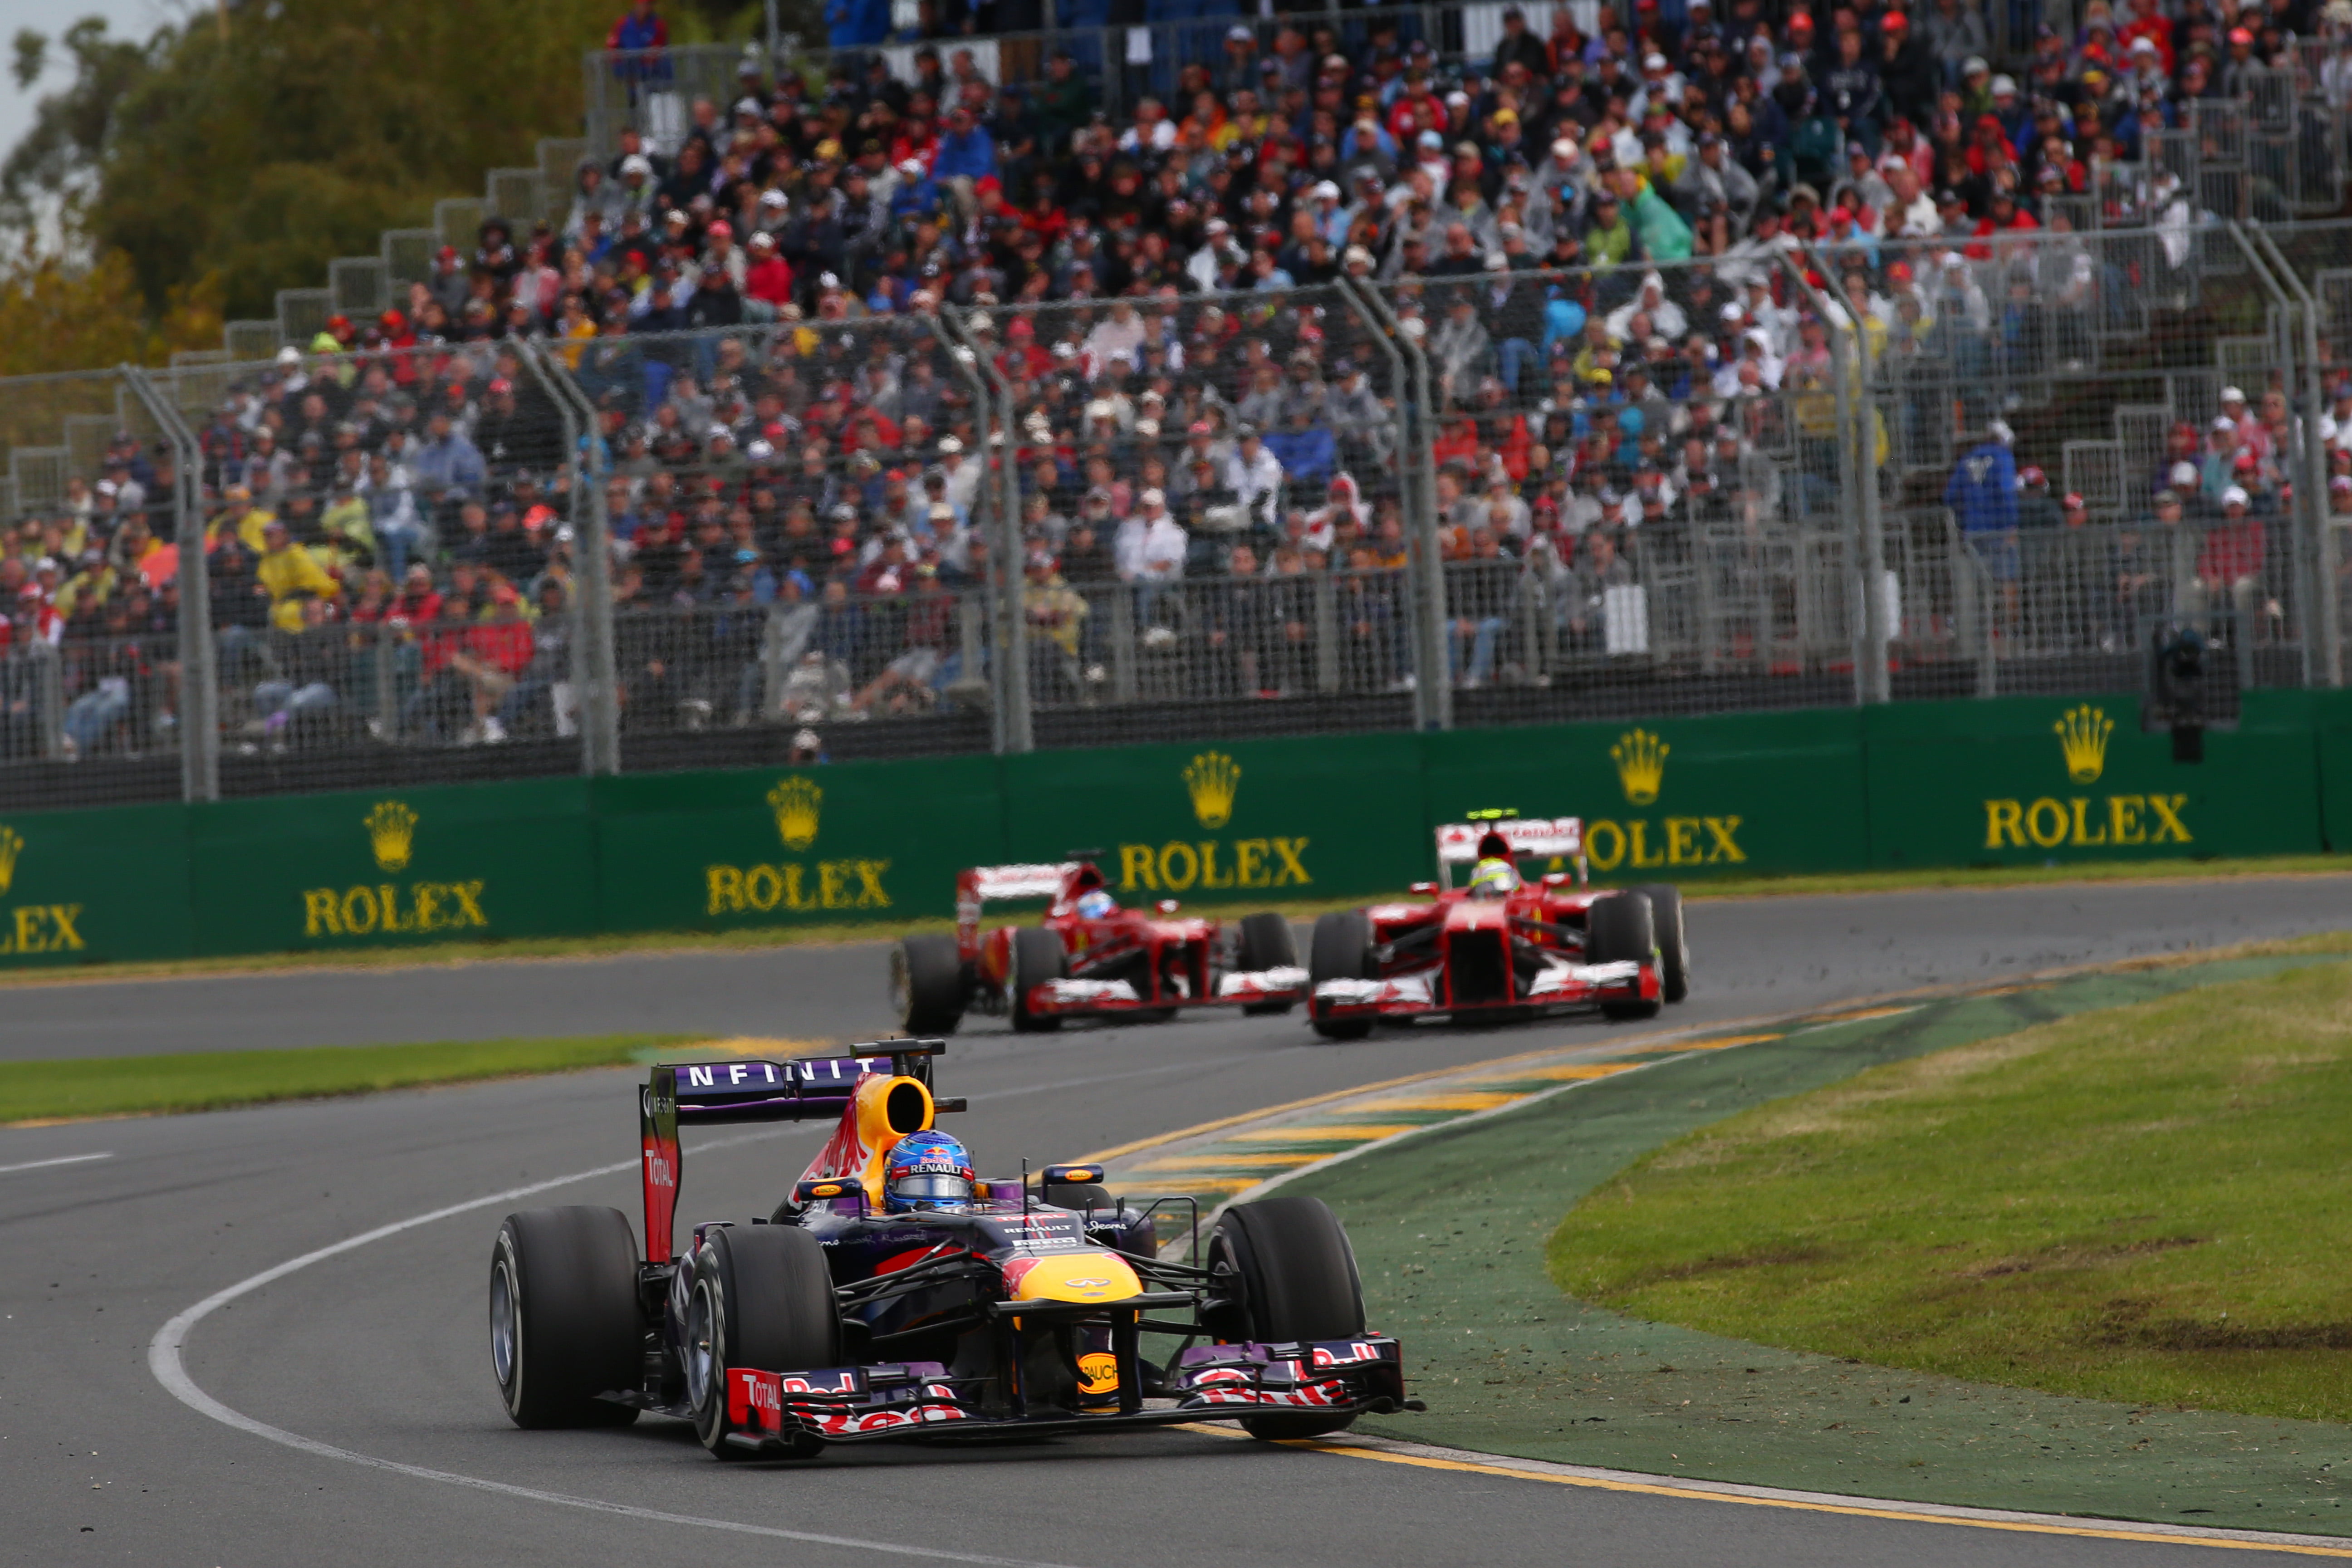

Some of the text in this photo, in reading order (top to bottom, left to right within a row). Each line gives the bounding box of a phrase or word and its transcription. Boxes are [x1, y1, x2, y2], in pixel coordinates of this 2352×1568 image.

[1984, 794, 2193, 848] ROLEX
[1548, 816, 1746, 872] OLEX
[1119, 837, 1311, 891] ROLEX
[706, 859, 891, 914] ROLEX
[303, 879, 488, 936] ROLEX
[689, 1058, 874, 1087] NFINIT
[645, 1149, 673, 1187] TOTAL
[911, 1164, 962, 1174] RENAULT
[1004, 1225, 1072, 1234] RENAULT
[1089, 1220, 1127, 1234] Jeans
[1313, 1343, 1379, 1369] Bll
[743, 1374, 780, 1410] TOTAL
